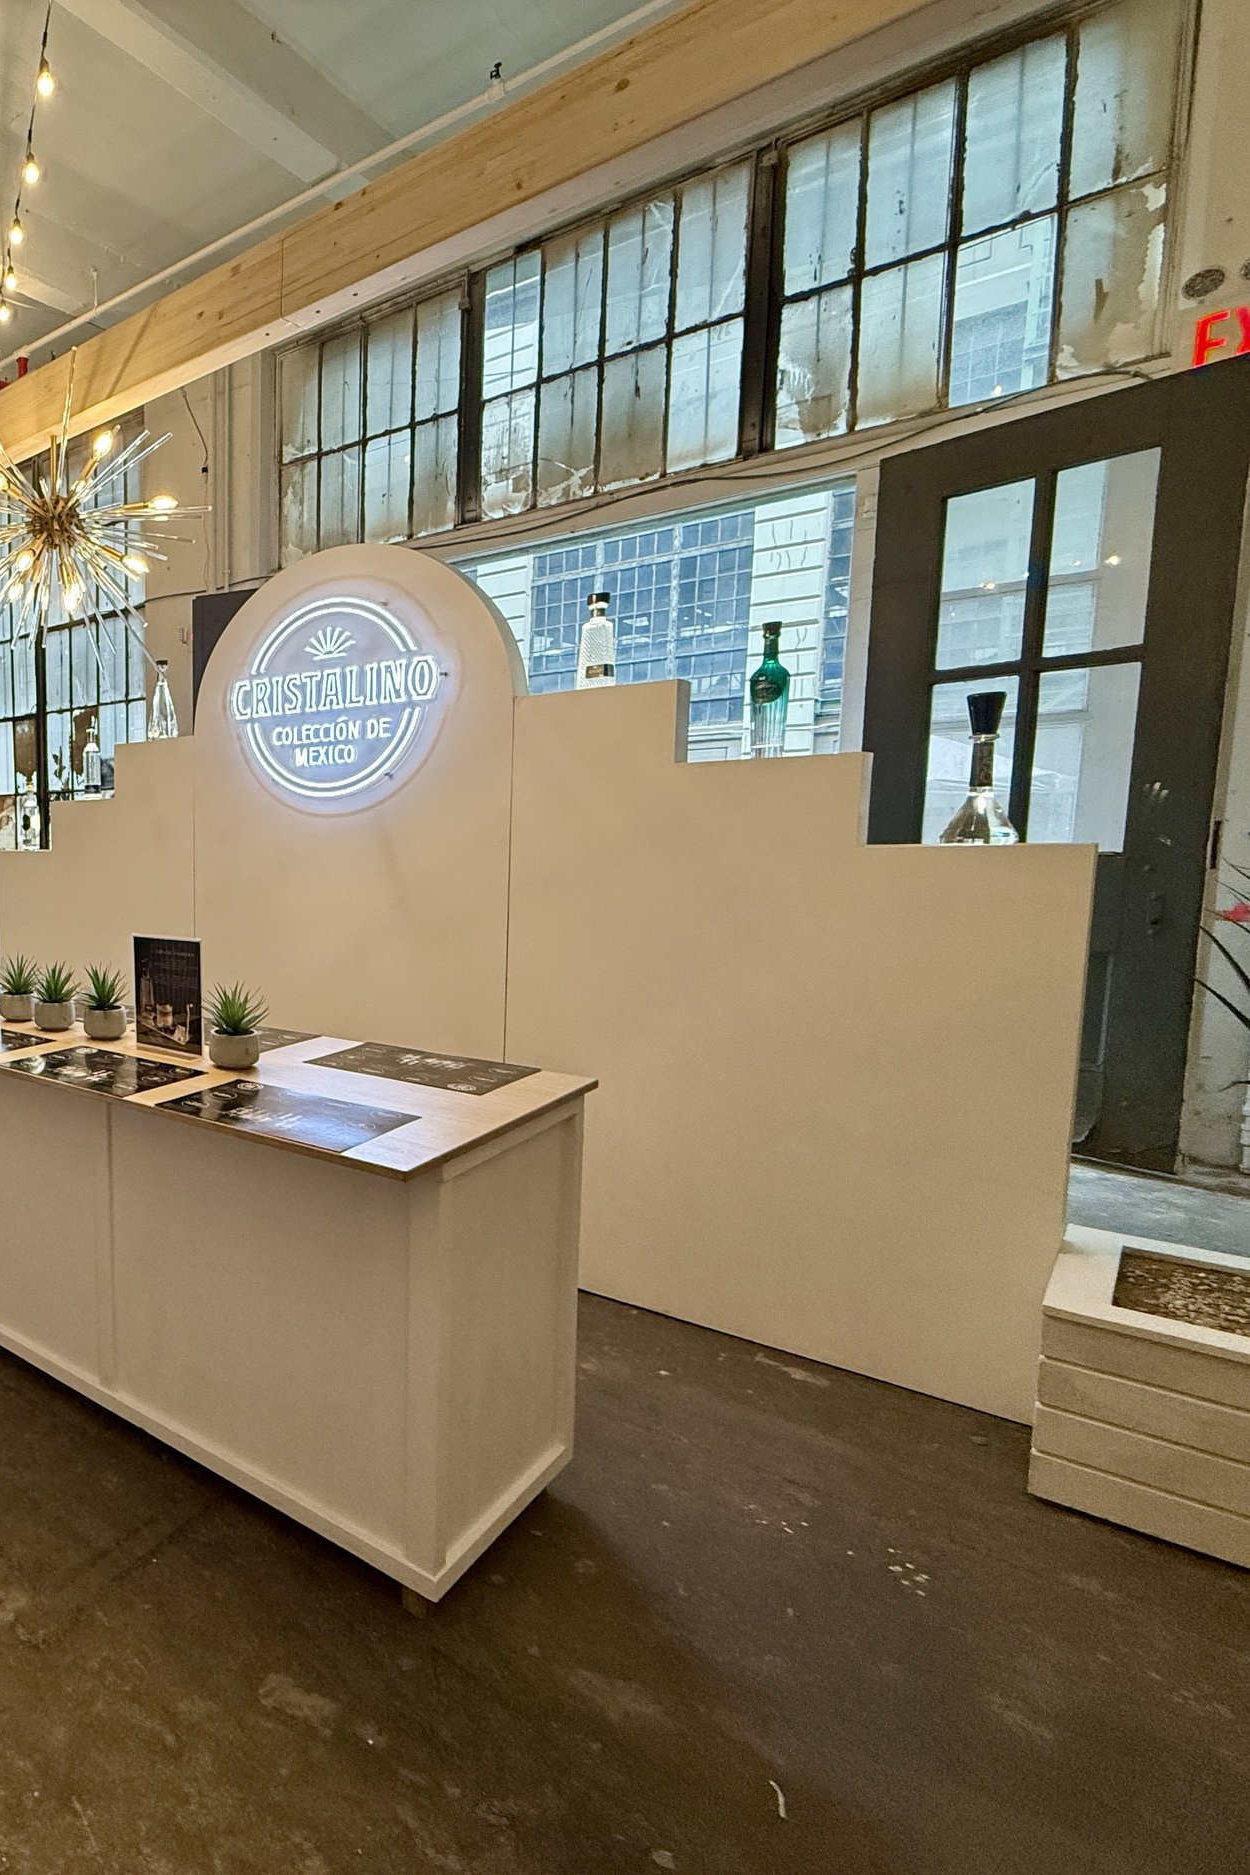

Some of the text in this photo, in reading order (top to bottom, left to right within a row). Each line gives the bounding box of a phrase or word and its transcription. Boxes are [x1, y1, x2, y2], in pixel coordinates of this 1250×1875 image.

[232, 655, 439, 720] CRISTALINO
[272, 716, 392, 746] COLECCIÓN DE
[295, 744, 356, 767] MEXICO
